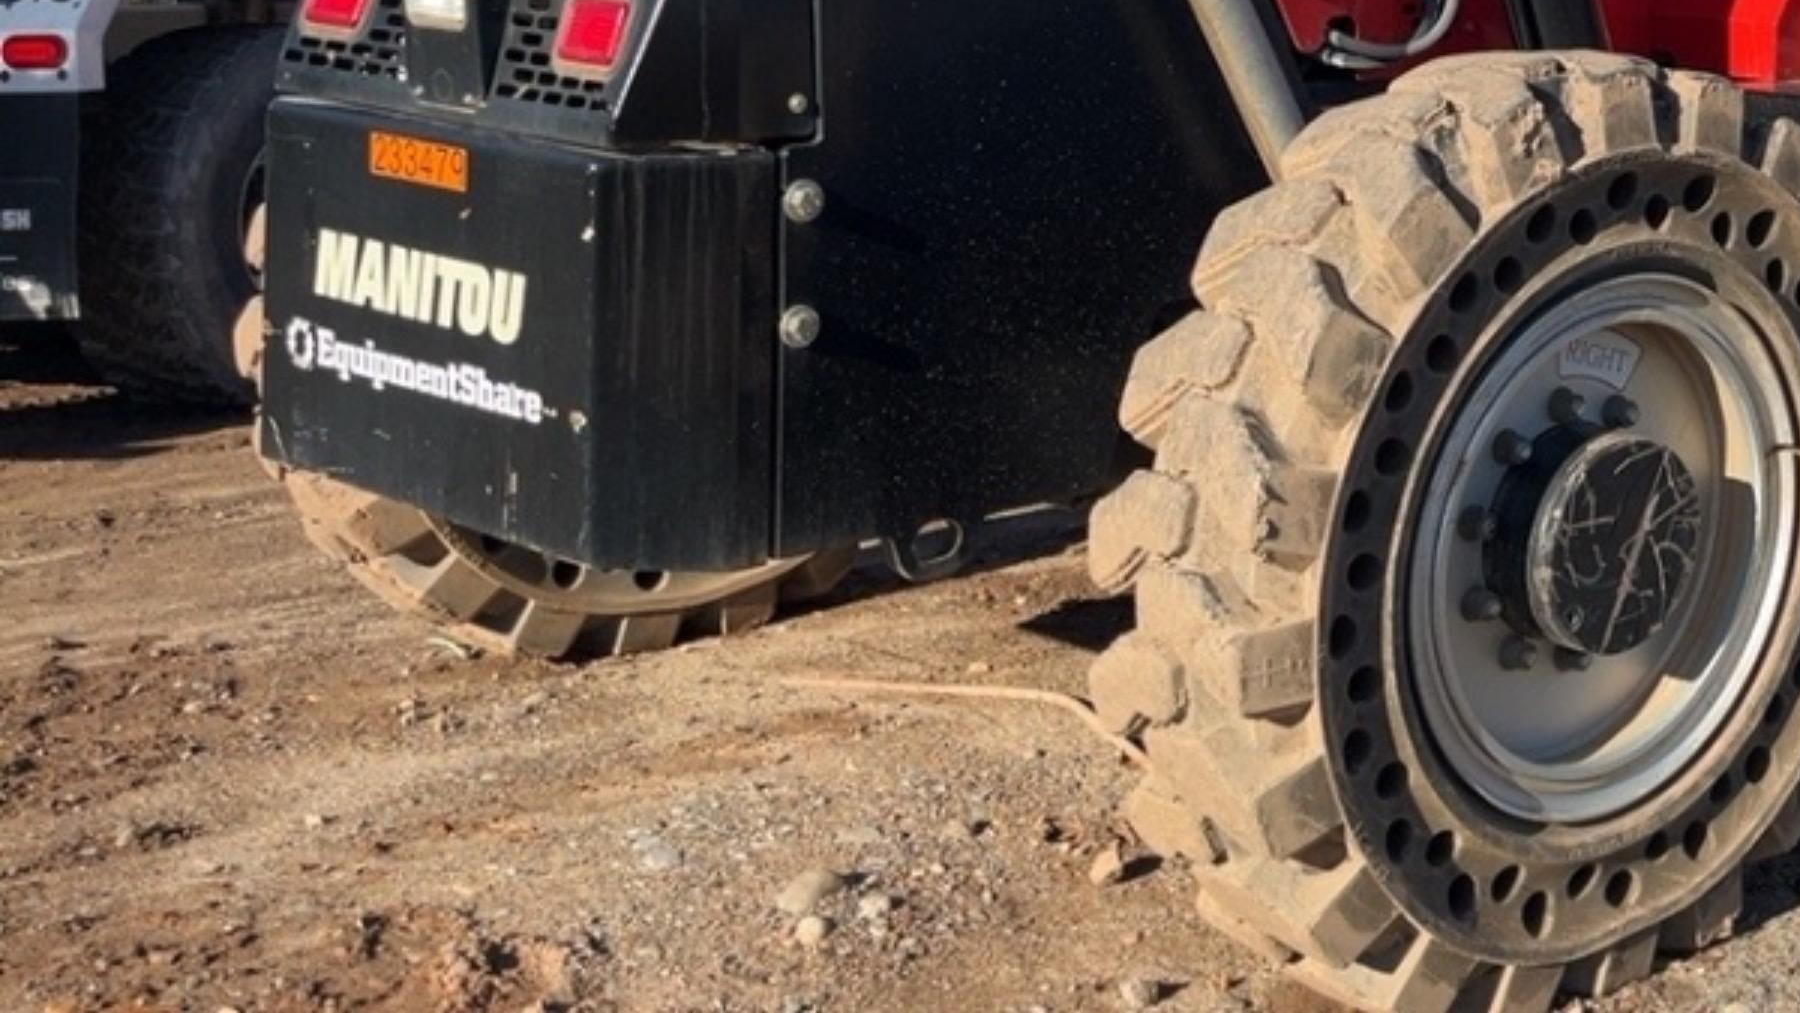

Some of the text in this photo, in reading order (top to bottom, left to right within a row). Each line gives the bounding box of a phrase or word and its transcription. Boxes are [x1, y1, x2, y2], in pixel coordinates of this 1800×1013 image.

[374, 134, 466, 184] 233479
[314, 227, 526, 345] MANITOU
[316, 325, 544, 423] EquipmentShare
